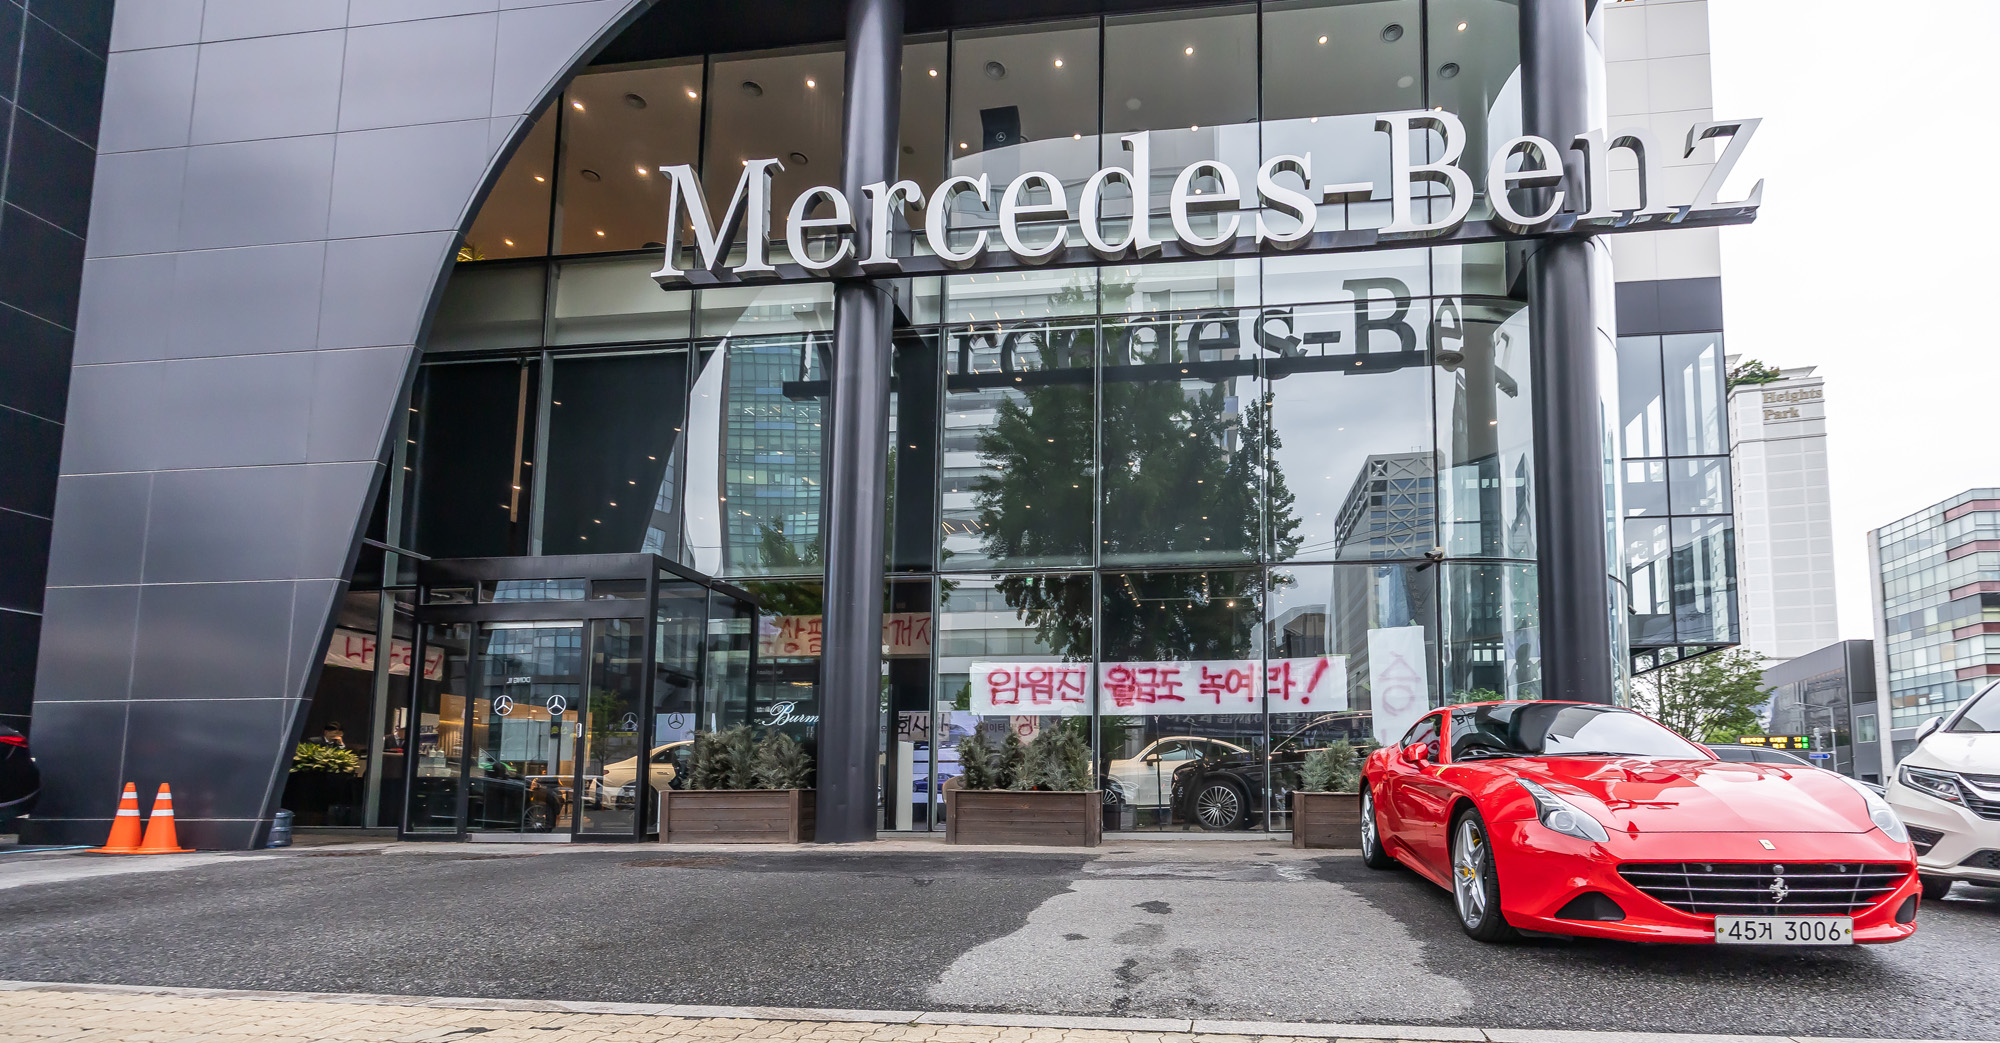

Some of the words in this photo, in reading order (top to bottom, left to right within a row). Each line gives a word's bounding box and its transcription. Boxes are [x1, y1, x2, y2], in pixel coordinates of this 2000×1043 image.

[650, 108, 1764, 281] Mercedes-Benz
[1762, 388, 1823, 404] Heights
[1762, 407, 1800, 421] Park
[987, 665, 1086, 705] 임원진
[1103, 664, 1185, 707] 월급도
[1728, 920, 1772, 940] 45거
[1784, 921, 1841, 941] 3006
